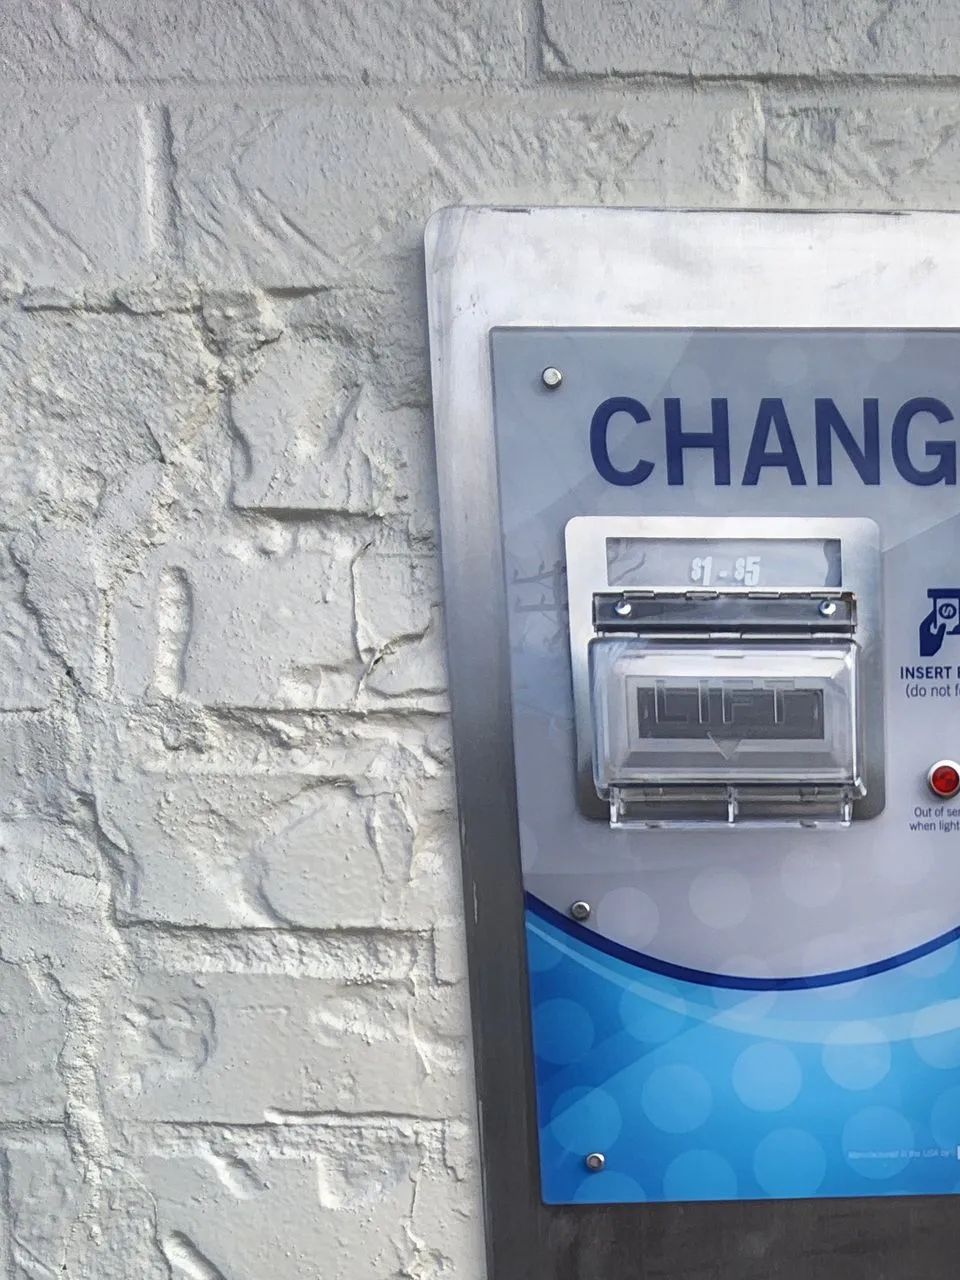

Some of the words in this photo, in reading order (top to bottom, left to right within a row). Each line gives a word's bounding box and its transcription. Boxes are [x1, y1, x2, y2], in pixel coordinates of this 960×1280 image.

[690, 556, 713, 586] $1
[734, 556, 761, 586] $5
[900, 665, 953, 680] INSERT
[905, 683, 927, 698] (do
[931, 684, 951, 697] not
[654, 679, 797, 724] LIFT
[914, 806, 932, 818] Out
[934, 806, 944, 817] of
[909, 820, 936, 832] when
[939, 819, 960, 833] light
